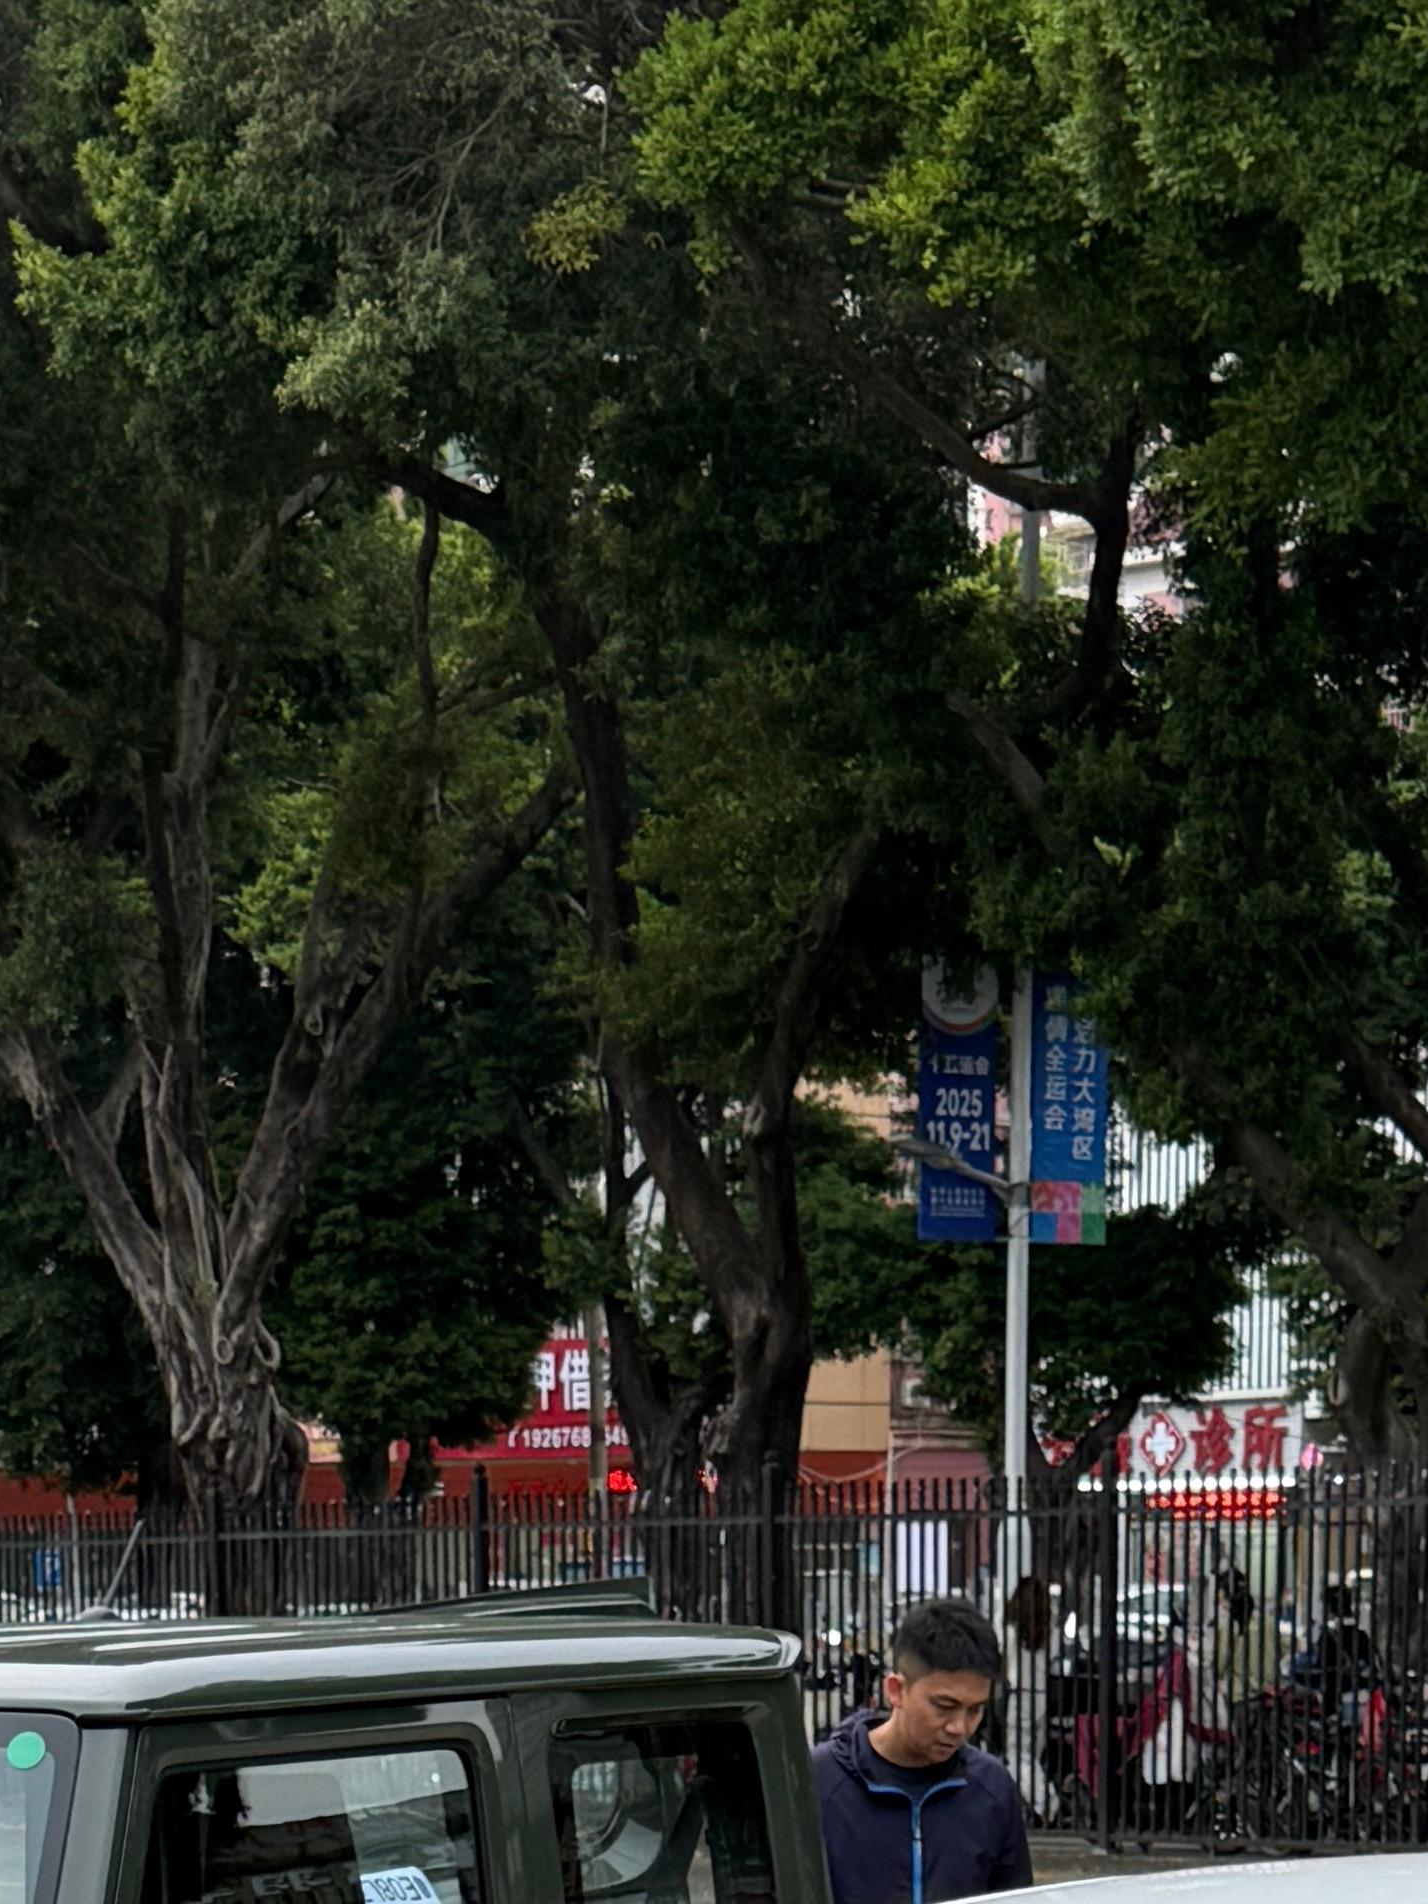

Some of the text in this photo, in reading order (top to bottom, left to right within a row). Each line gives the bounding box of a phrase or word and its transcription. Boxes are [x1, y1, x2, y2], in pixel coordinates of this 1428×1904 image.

[935, 1087, 983, 1118] 2025
[926, 1120, 991, 1156] 11.9-21
[1189, 1404, 1289, 1474] 诊所
